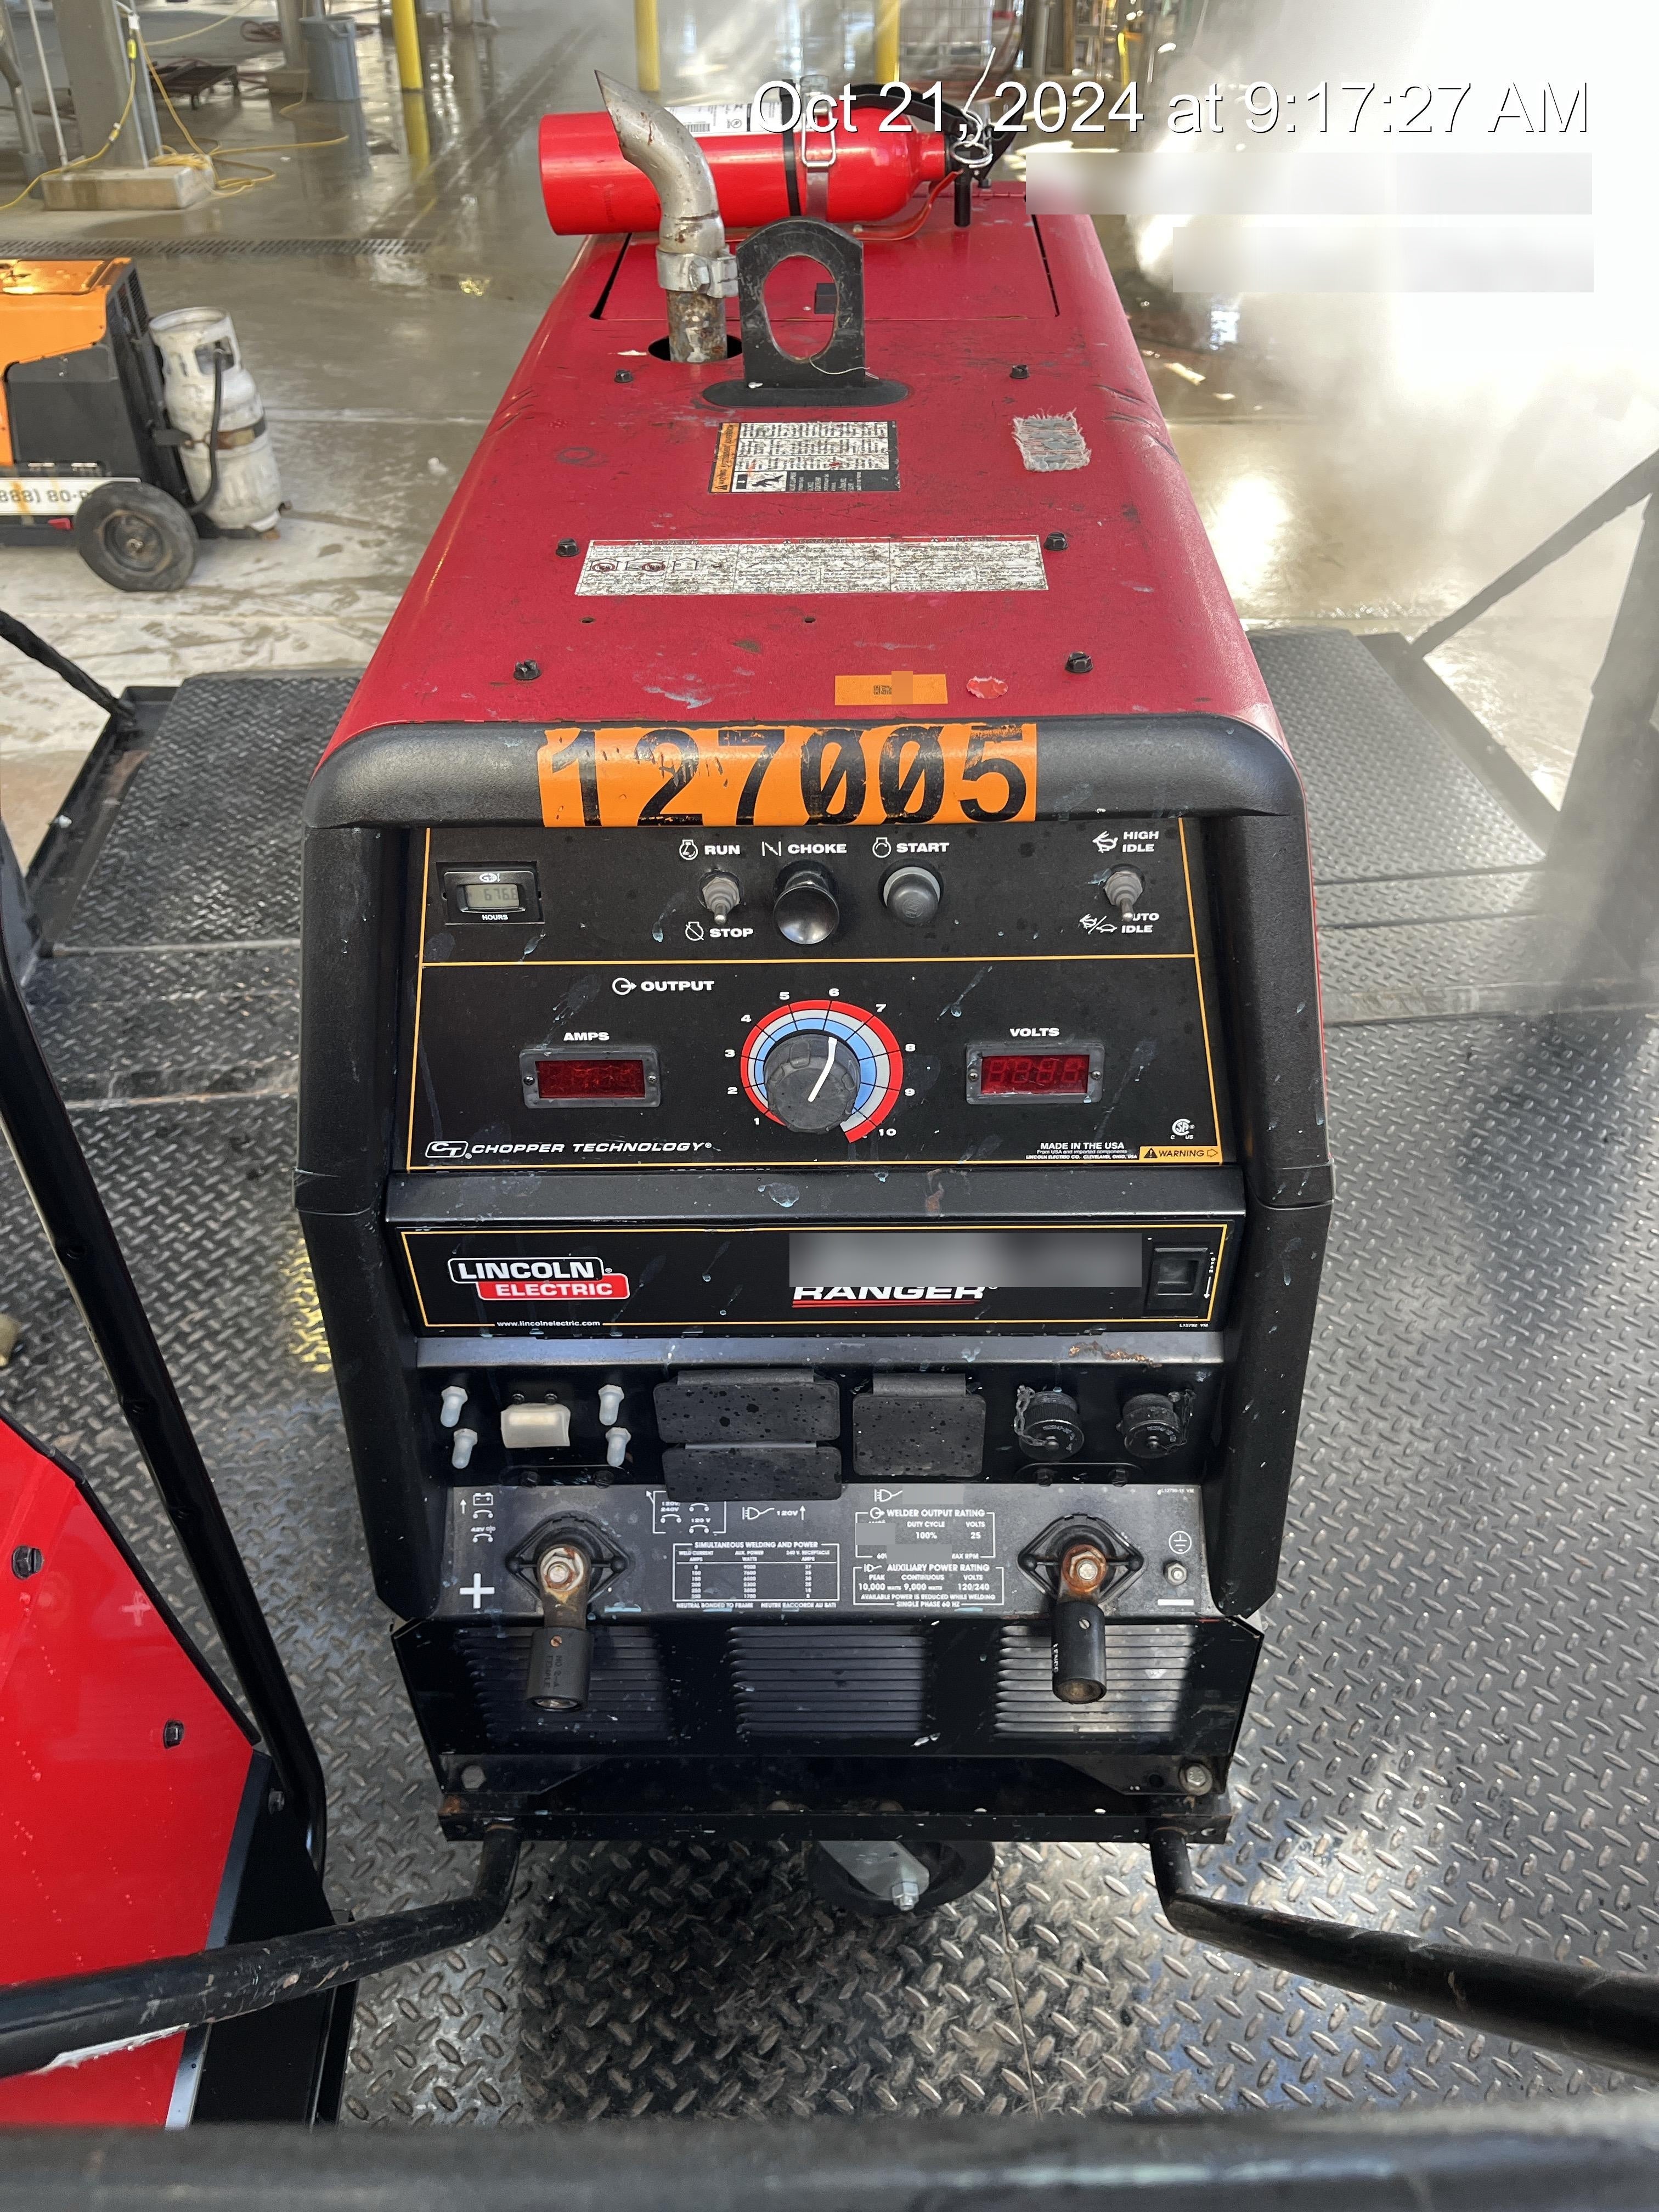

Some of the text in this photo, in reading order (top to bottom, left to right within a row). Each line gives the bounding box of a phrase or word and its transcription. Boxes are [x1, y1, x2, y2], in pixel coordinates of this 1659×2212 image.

[552, 725, 1028, 826] 127005
[1124, 831, 1159, 840] HIGH
[704, 845, 740, 855] RUN
[788, 843, 847, 854] CHOKE
[896, 842, 950, 853] START
[1122, 843, 1155, 853] IDLE
[1131, 912, 1160, 922] UTO
[710, 927, 753, 938] STOP
[1121, 924, 1153, 933] IDLE
[641, 980, 714, 991] OUTPUT
[779, 991, 790, 1000] 5
[828, 988, 840, 997] 6
[876, 1003, 887, 1012] 7
[741, 1014, 752, 1023] 4
[563, 1032, 610, 1041] AMPS
[1009, 1028, 1060, 1037] VOLTS
[905, 1043, 916, 1052] 8
[724, 1049, 736, 1058] 3
[727, 1087, 738, 1095] 2
[905, 1088, 915, 1097] 9
[878, 1128, 896, 1136] 10
[471, 1143, 566, 1154] CHOPPER
[458, 1261, 595, 1280] LINCOLN
[496, 1282, 613, 1296] ELECTRIC
[859, 1583, 885, 1591] 10,000
[904, 1583, 927, 1591] 9,000
[957, 1583, 990, 1591] 120/240
